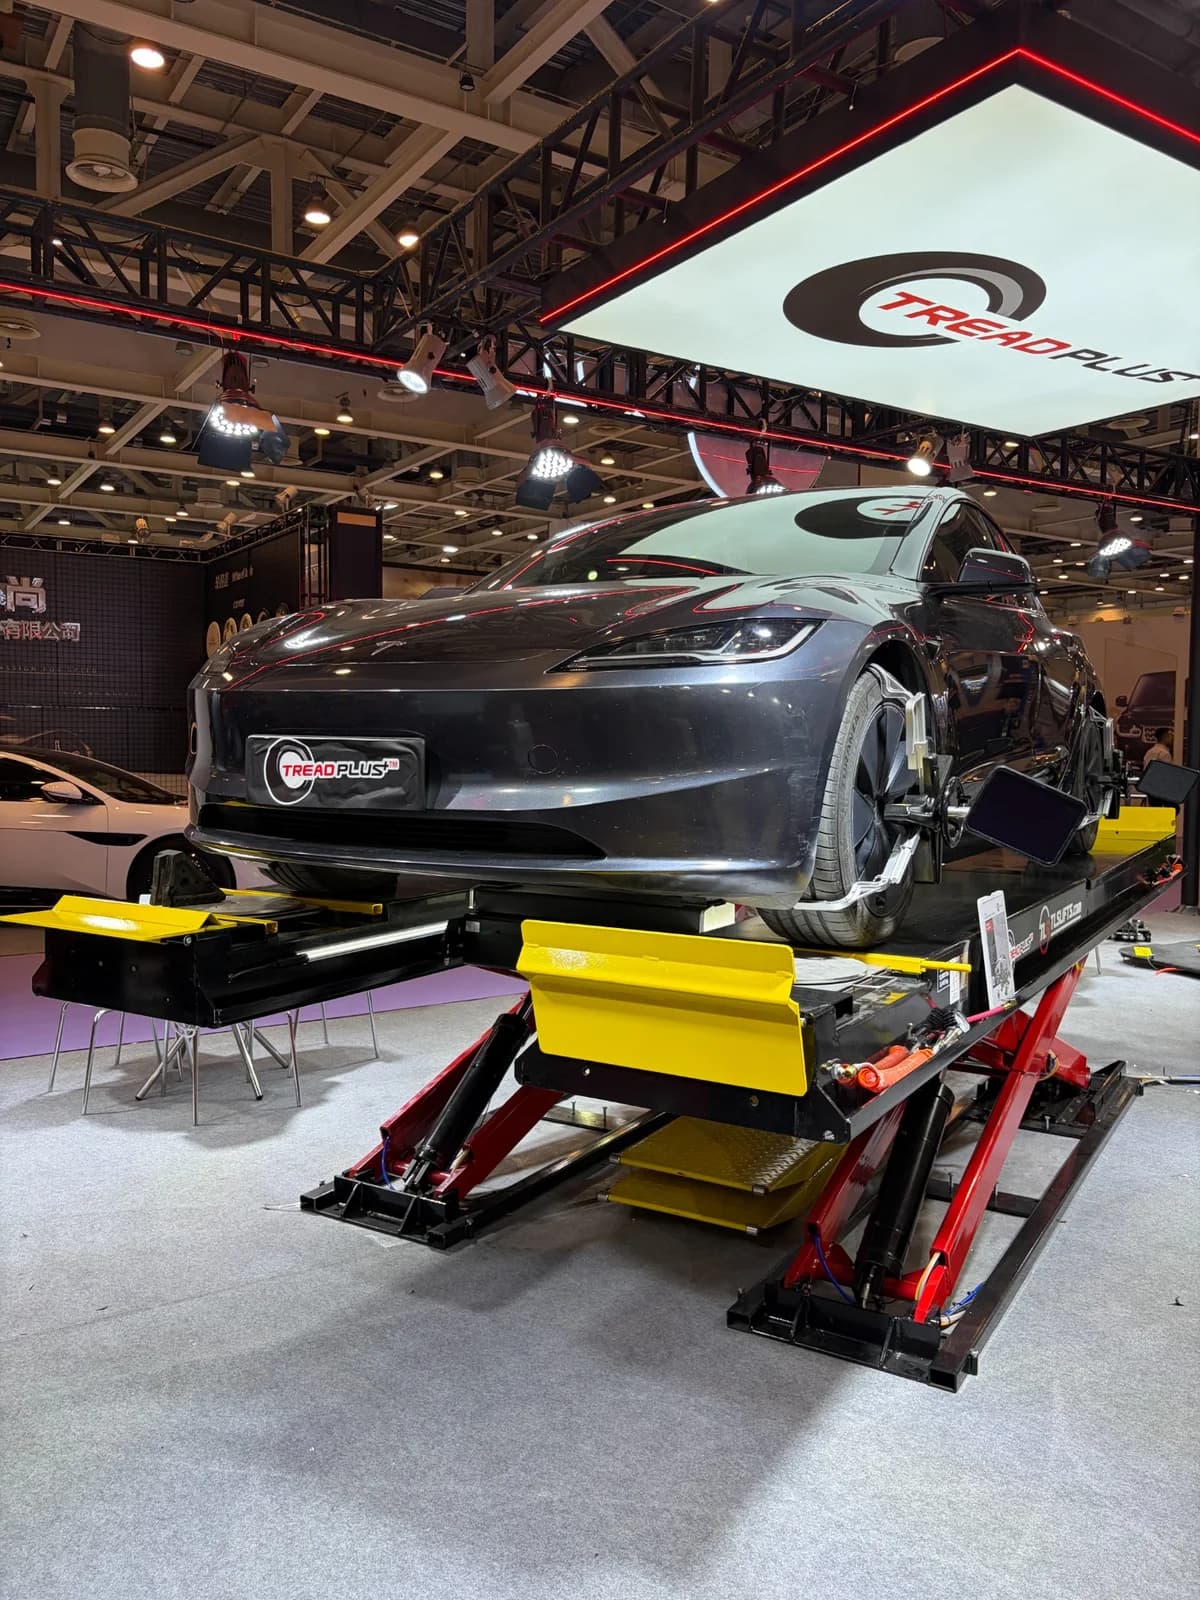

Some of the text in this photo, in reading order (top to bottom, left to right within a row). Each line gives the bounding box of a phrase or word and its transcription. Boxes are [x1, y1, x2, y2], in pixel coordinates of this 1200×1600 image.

[0, 576, 47, 613] 尚
[0, 619, 81, 641] 有限公司
